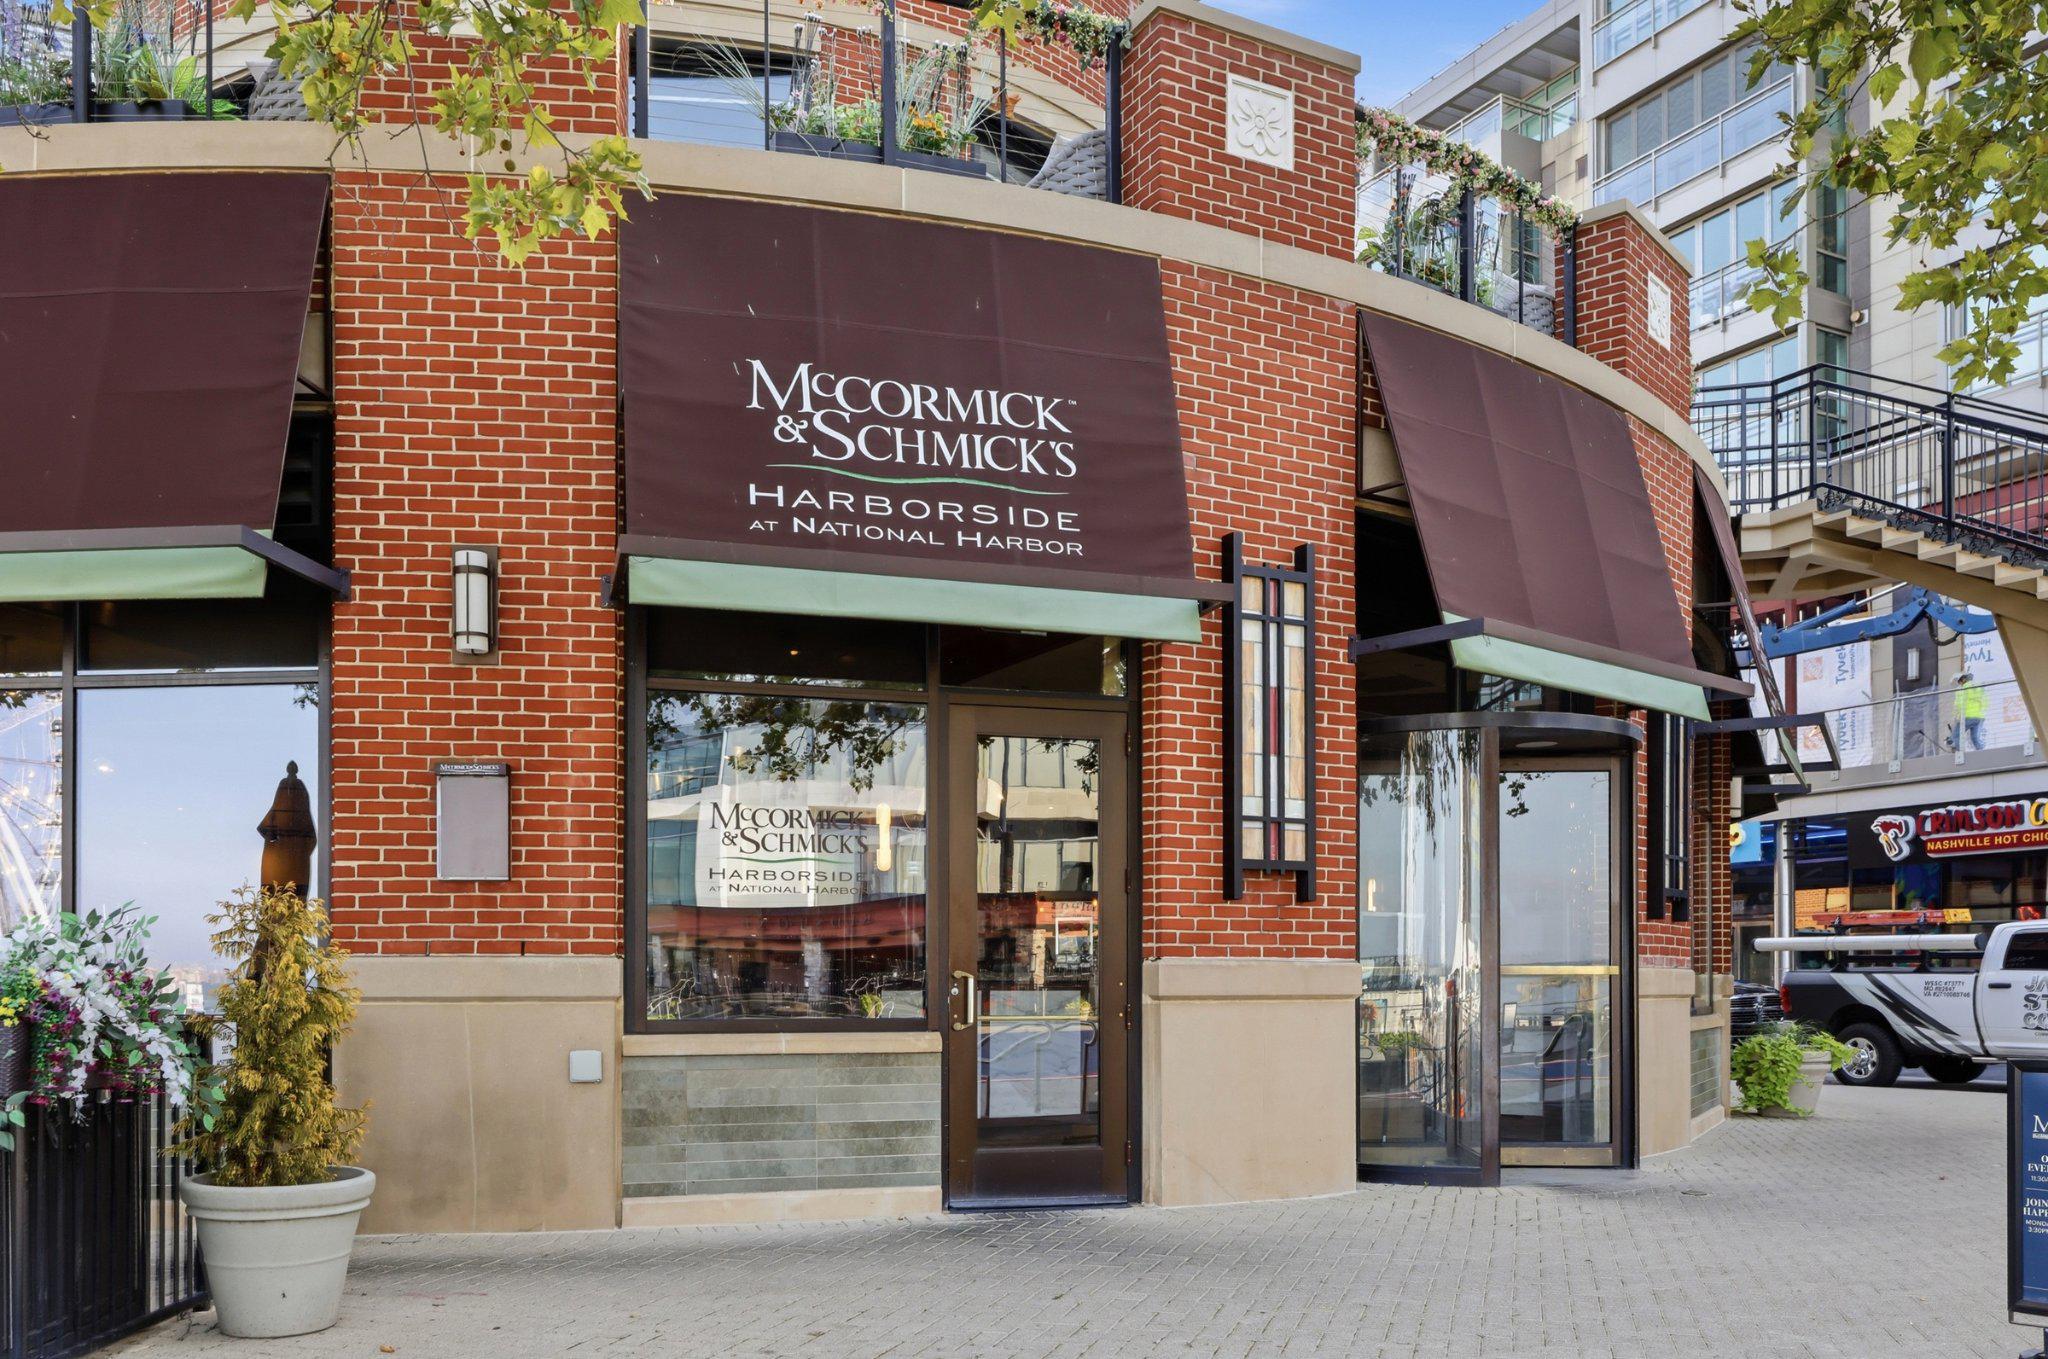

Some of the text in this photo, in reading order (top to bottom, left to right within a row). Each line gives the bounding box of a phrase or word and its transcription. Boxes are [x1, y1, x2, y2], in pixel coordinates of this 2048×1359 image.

[773, 408, 1077, 477] & SCHMICK'S
[749, 483, 1081, 532] HARBORSIDE
[749, 516, 1084, 556] AT NATIONAL HARBOR
[1916, 800, 2048, 837] CRIMSON C
[721, 831, 738, 847] &
[1927, 836, 1991, 851] NASHVILLE
[1994, 834, 2019, 845] HOT
[709, 867, 870, 882] HARBORSIDE
[729, 883, 801, 894] NATIONAL
